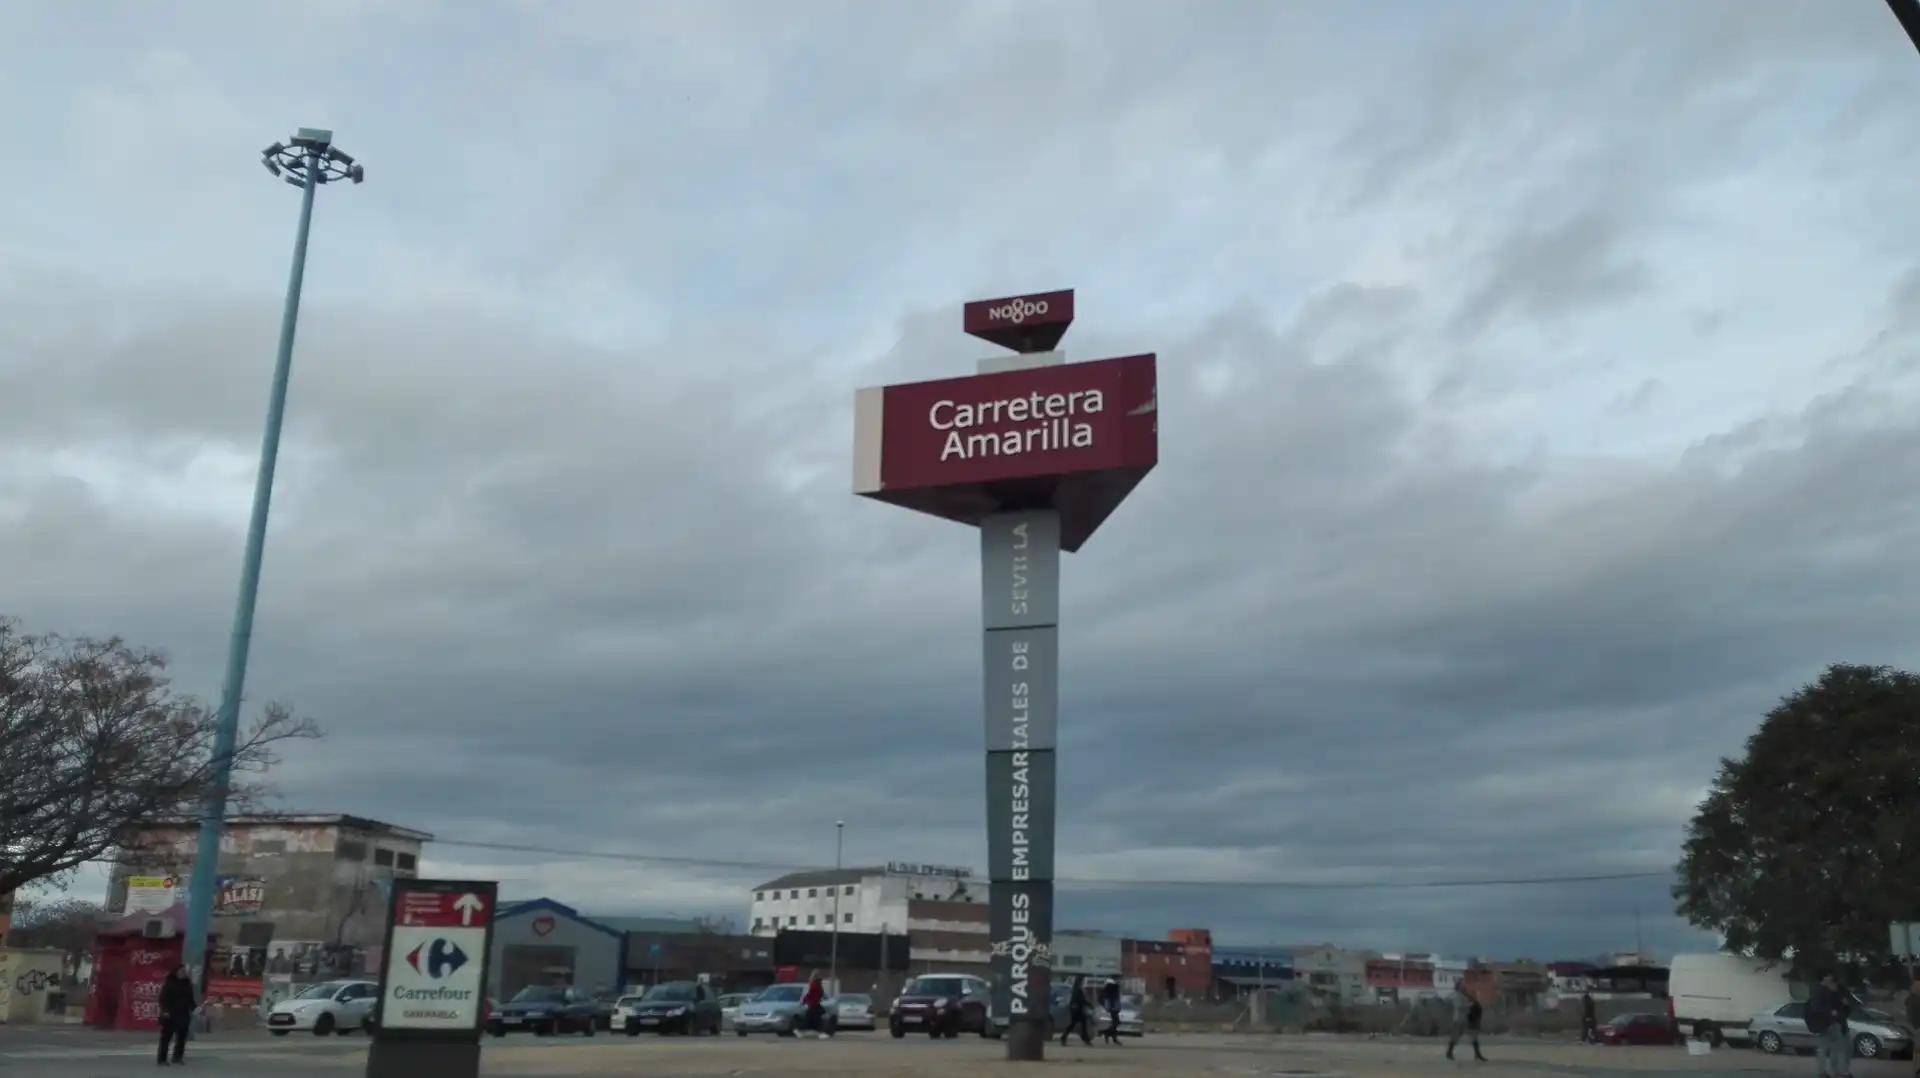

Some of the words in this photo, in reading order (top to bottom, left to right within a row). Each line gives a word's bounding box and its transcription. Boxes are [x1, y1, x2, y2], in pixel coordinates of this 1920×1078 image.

[929, 389, 1103, 430] Carretera
[940, 418, 1092, 461] Amarilla
[1012, 523, 1028, 614] SEVILLA
[1012, 642, 1029, 670] DE
[1012, 682, 1028, 881] EMPRESARIALES
[1011, 893, 1029, 1014] PARQUES
[394, 986, 472, 1000] Carrefour
